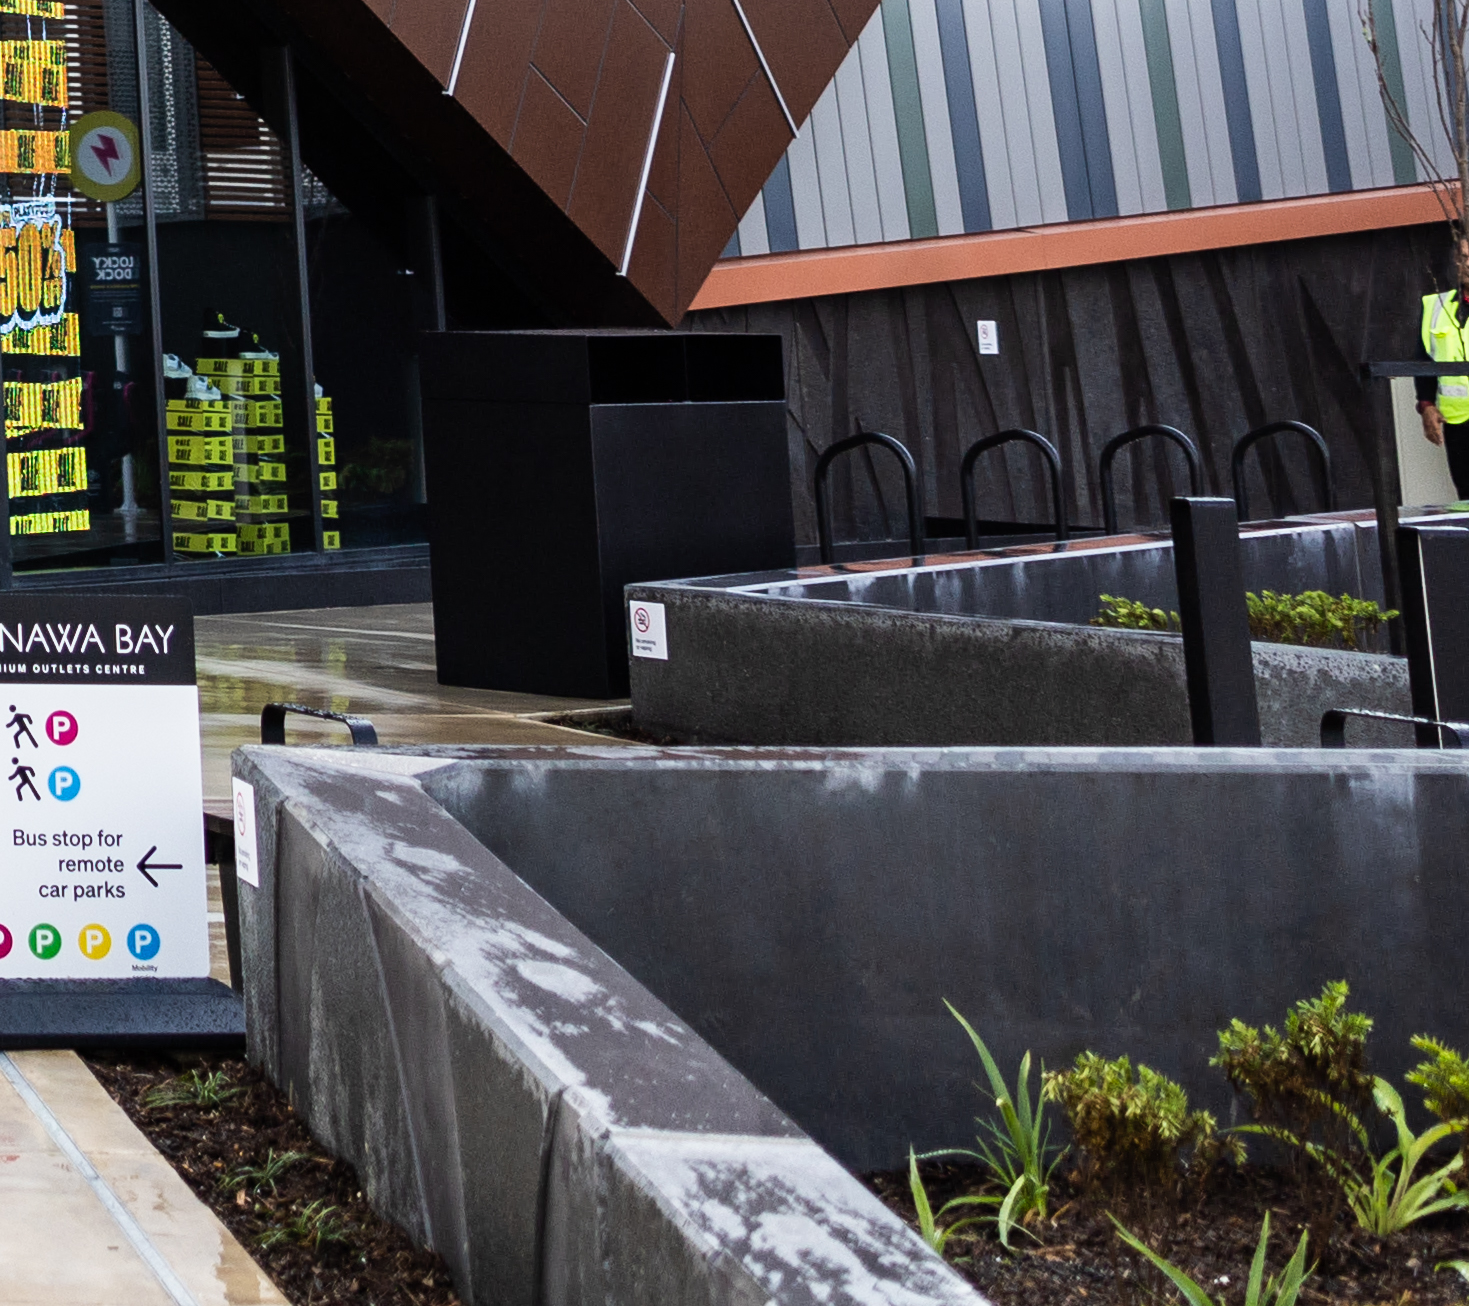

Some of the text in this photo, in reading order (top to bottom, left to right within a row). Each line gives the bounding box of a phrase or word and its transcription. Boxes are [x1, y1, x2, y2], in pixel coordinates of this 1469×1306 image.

[177, 415, 193, 427] SALE
[175, 448, 192, 461] SALE
[115, 623, 174, 655] BAY
[33, 664, 90, 675] OUTLETS
[96, 665, 145, 675] CENTRE
[13, 829, 123, 851] Bus stop for
[58, 858, 125, 874] remote
[38, 881, 126, 903] car parks
